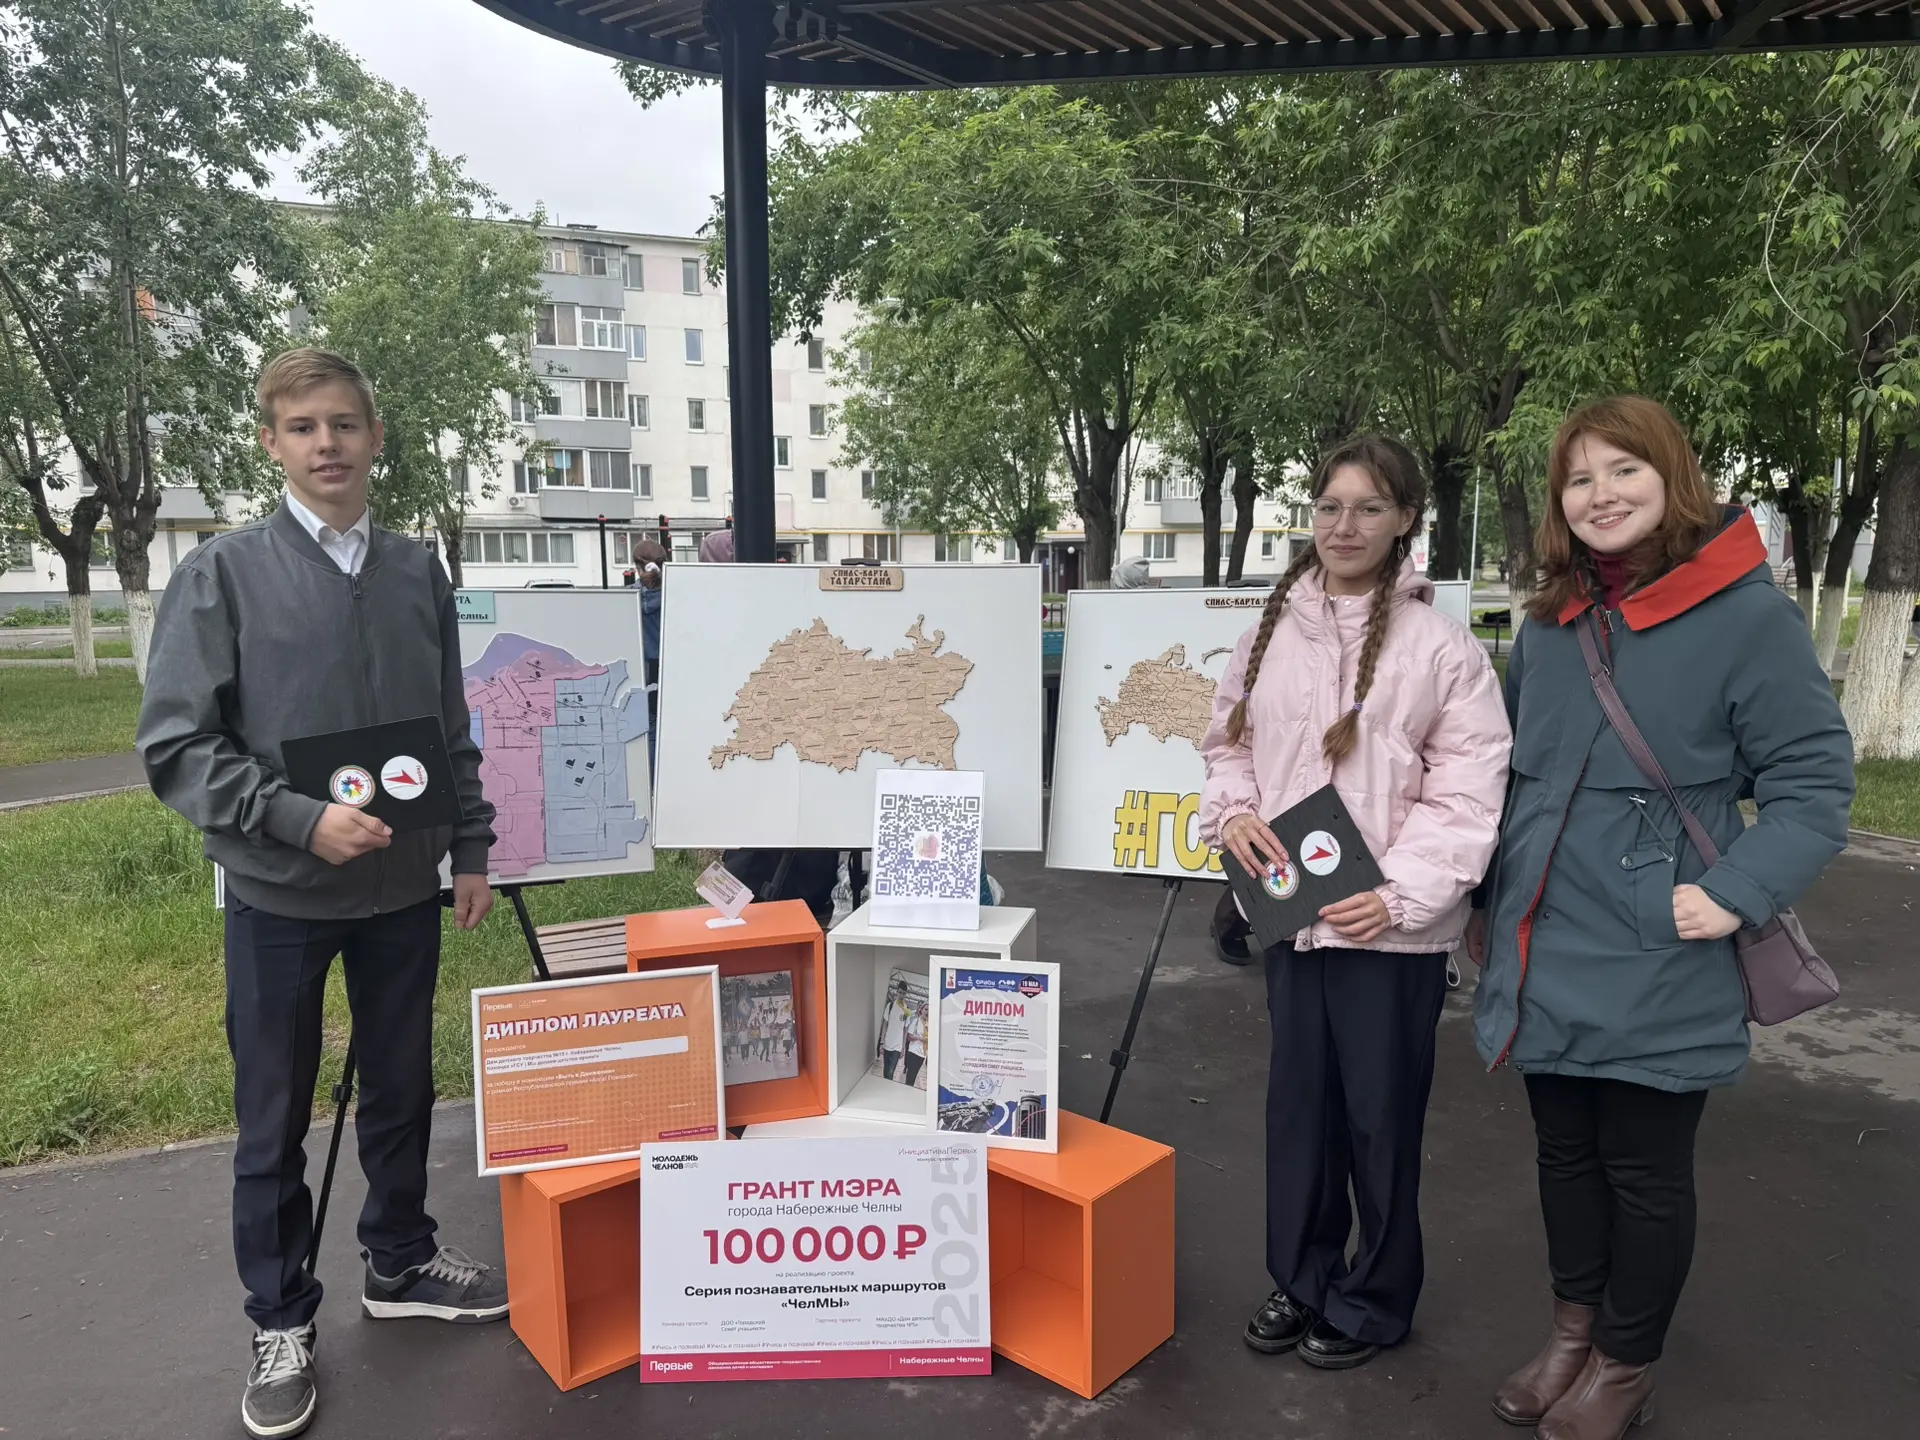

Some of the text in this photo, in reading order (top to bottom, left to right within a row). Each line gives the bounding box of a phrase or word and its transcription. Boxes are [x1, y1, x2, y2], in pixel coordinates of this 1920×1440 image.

[833, 569, 888, 577] СПИЛС-КАРТА
[830, 577, 892, 586] ТАТАРСТАНА
[1205, 597, 1261, 606] СПИЛС-КАРТА
[963, 1000, 1025, 1017] ДИПЛОМ
[484, 1002, 686, 1040] ДИПЛОМ ЛАУРЕАТА
[652, 1154, 699, 1163] МОЛОДЕЖЬ
[728, 1178, 901, 1200] ГРАНТ МЭРА
[728, 1202, 902, 1218] города Набережные Челны
[931, 1143, 980, 1337] 2025
[684, 1282, 947, 1298] Серия познавательных маршрутов
[781, 1298, 850, 1309] «ЧелМЫ»
[649, 1360, 694, 1374] Первые
[899, 1356, 984, 1366] Набережные Челны
